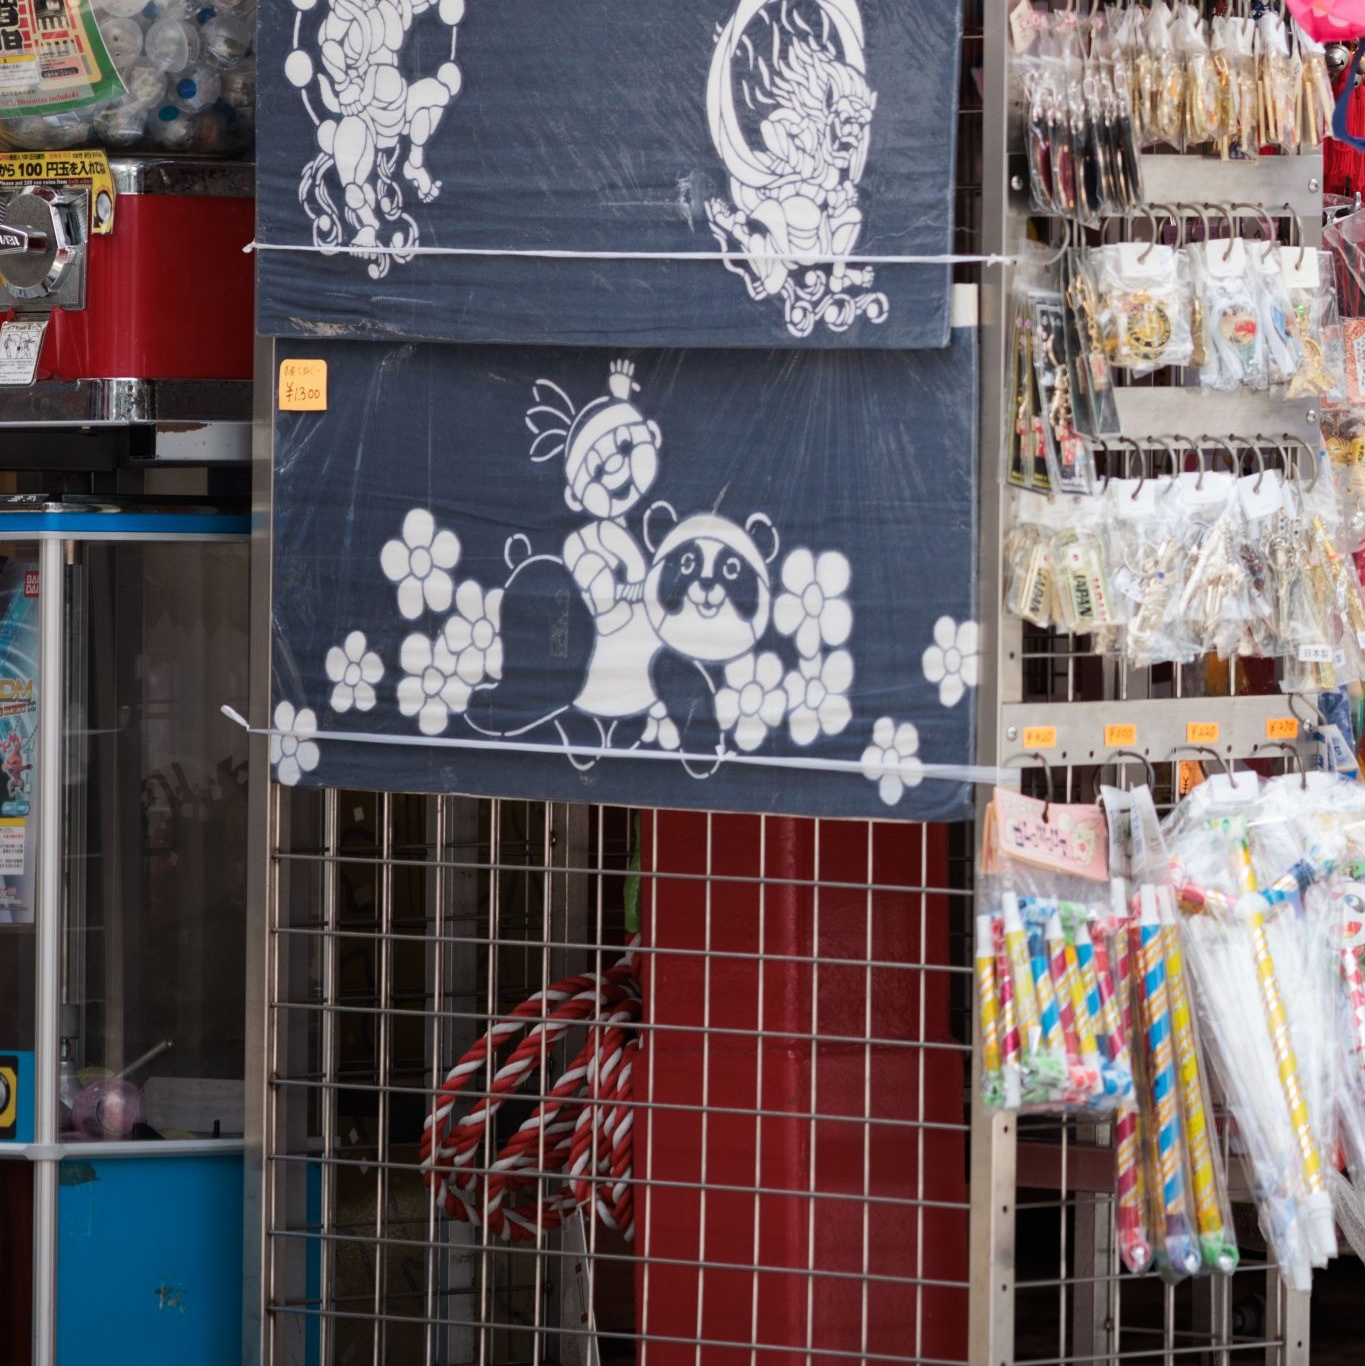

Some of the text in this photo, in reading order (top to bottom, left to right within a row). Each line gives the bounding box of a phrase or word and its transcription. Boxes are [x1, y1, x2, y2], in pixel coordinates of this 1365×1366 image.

[18, 162, 43, 177] 100
[46, 160, 106, 177] 円玉を入れてね
[1303, 647, 1329, 660] 日本製
